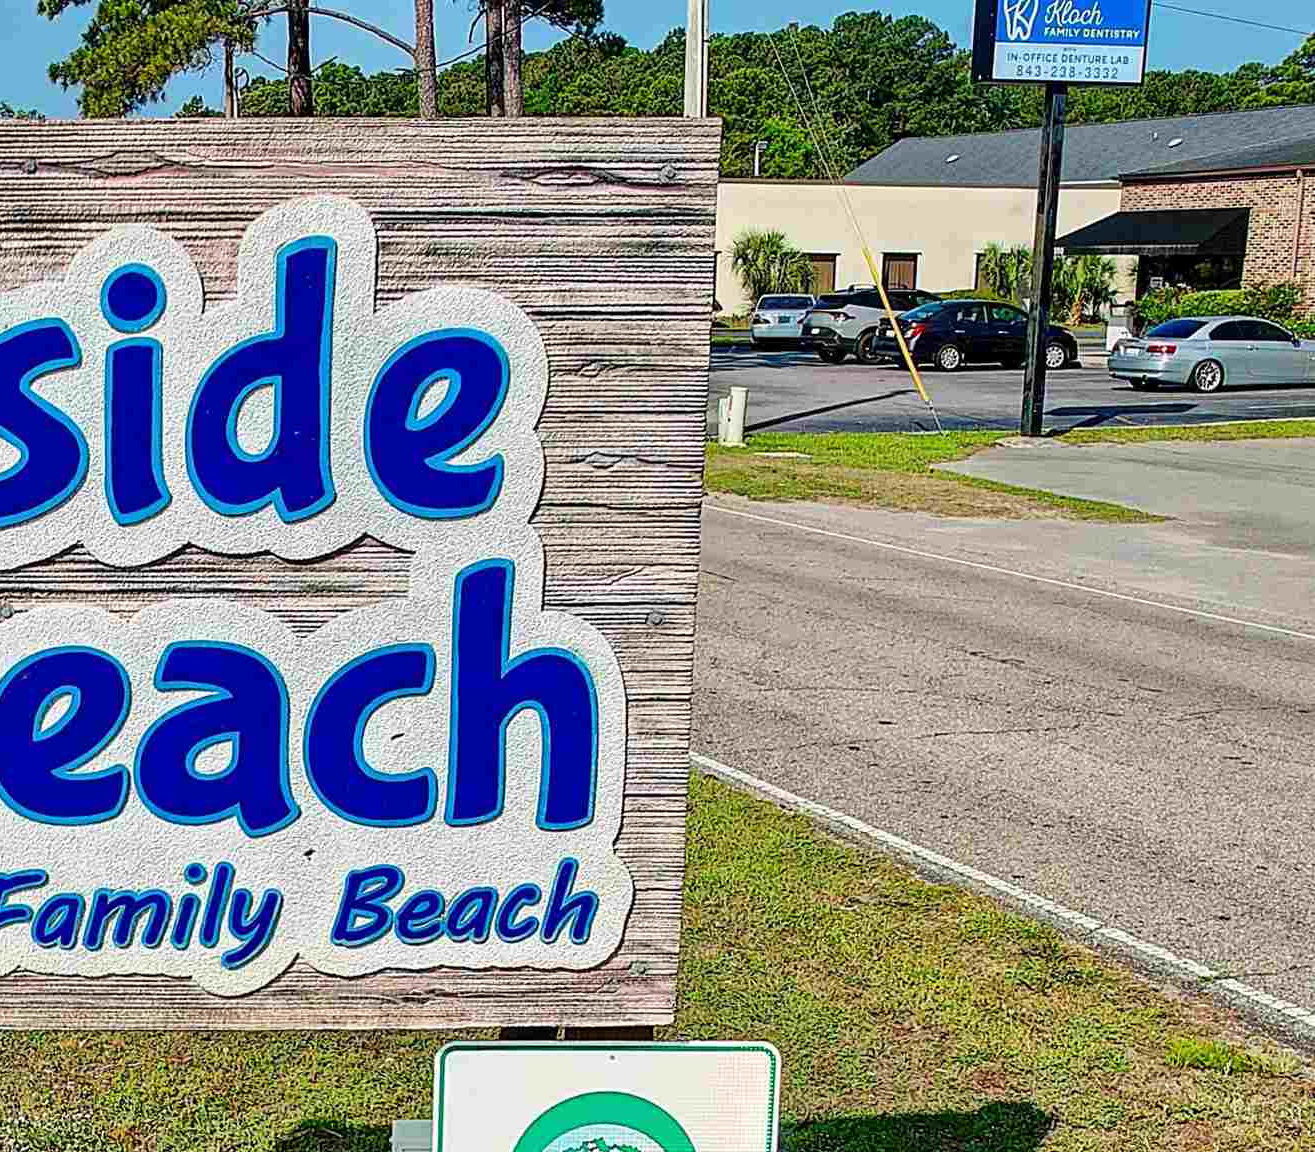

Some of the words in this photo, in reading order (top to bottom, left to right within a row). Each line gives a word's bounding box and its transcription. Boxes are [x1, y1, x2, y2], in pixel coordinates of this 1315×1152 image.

[1045, 0, 1103, 27] Kloch
[1044, 27, 1081, 38] FAMILY
[1083, 29, 1140, 40] DENTISTRY
[1006, 52, 1058, 63] IN-OFFICE
[1061, 53, 1109, 64] DENTURE
[1016, 64, 1118, 79] 843-238-3332
[330, 857, 599, 947] Beach
